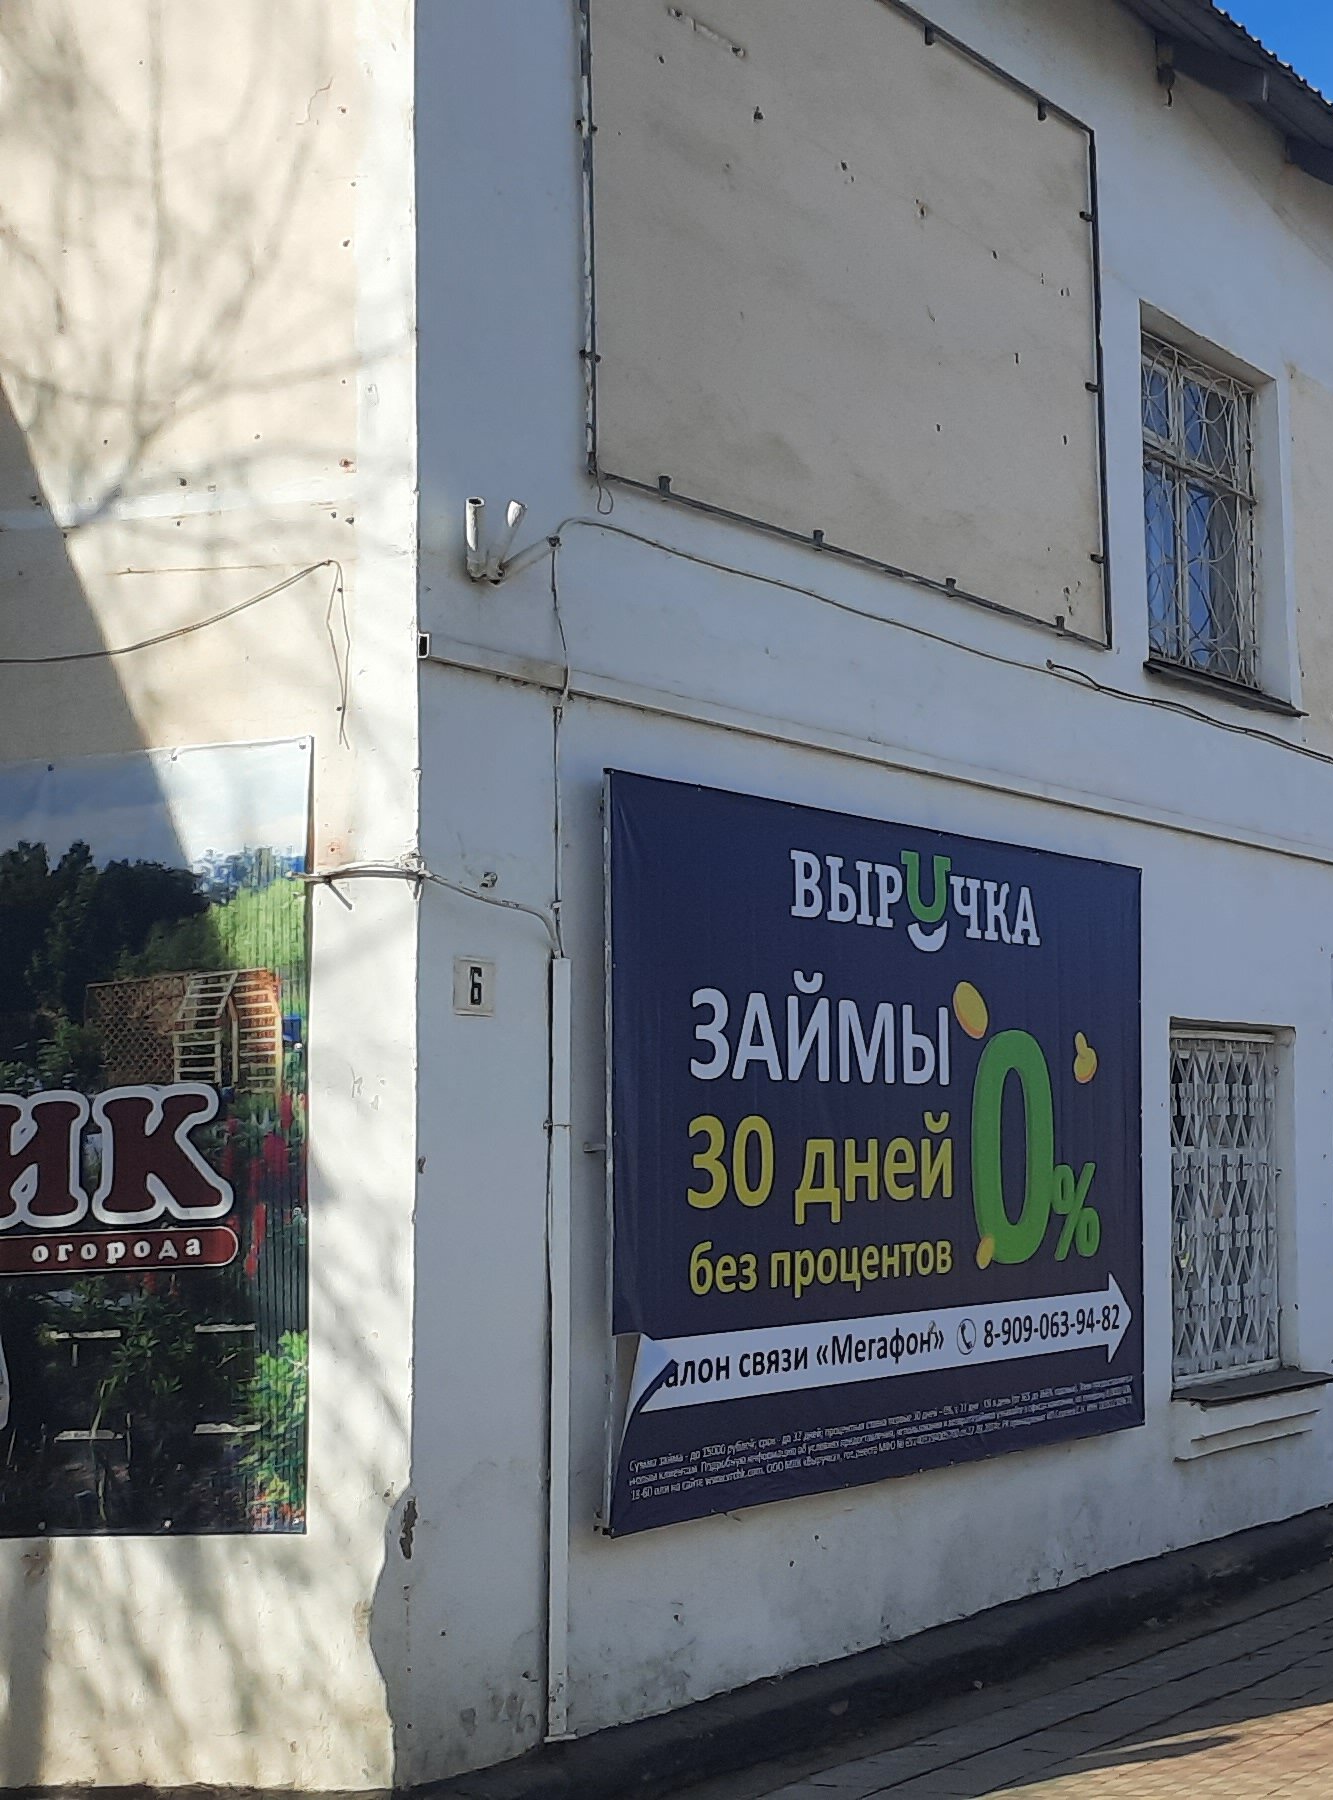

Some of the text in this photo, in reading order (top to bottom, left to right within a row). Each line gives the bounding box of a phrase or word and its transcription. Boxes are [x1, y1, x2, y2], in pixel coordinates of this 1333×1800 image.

[790, 849, 1041, 952] ВЫРУЧКА
[469, 966, 483, 1006] 6
[689, 969, 951, 1086] ЗАЙМЫ
[687, 1110, 954, 1226] 30 дней
[970, 1028, 1102, 1265] 0%
[31, 1237, 202, 1265] огорода
[688, 1239, 954, 1300] без процентов
[664, 1303, 1121, 1388] алон связи «Мегафон» 8-909-063-94-82
